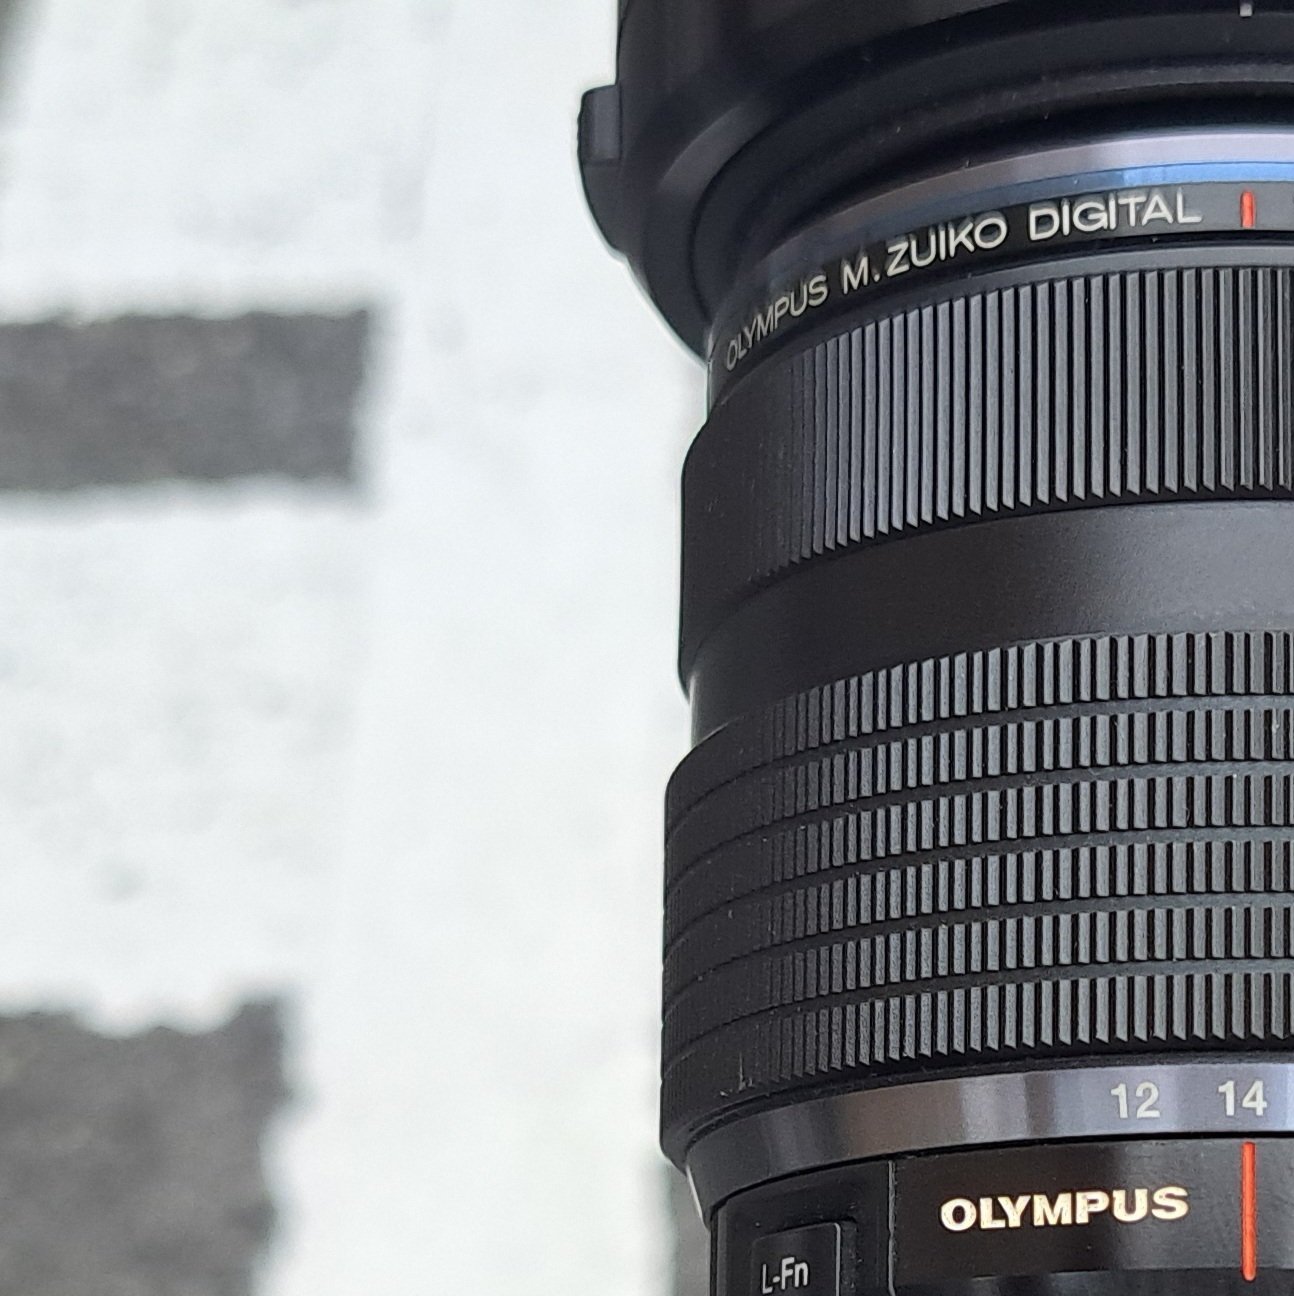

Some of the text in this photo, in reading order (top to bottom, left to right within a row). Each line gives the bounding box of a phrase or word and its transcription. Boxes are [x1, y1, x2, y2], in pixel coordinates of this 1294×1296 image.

[726, 274, 829, 371] OLYMPUS
[1028, 185, 1203, 241] DIGITAL
[1110, 1080, 1161, 1119] 12
[1217, 1080, 1268, 1116] 14
[940, 1185, 1189, 1231] OLYMPUS
[761, 1256, 809, 1294] L-Fn
